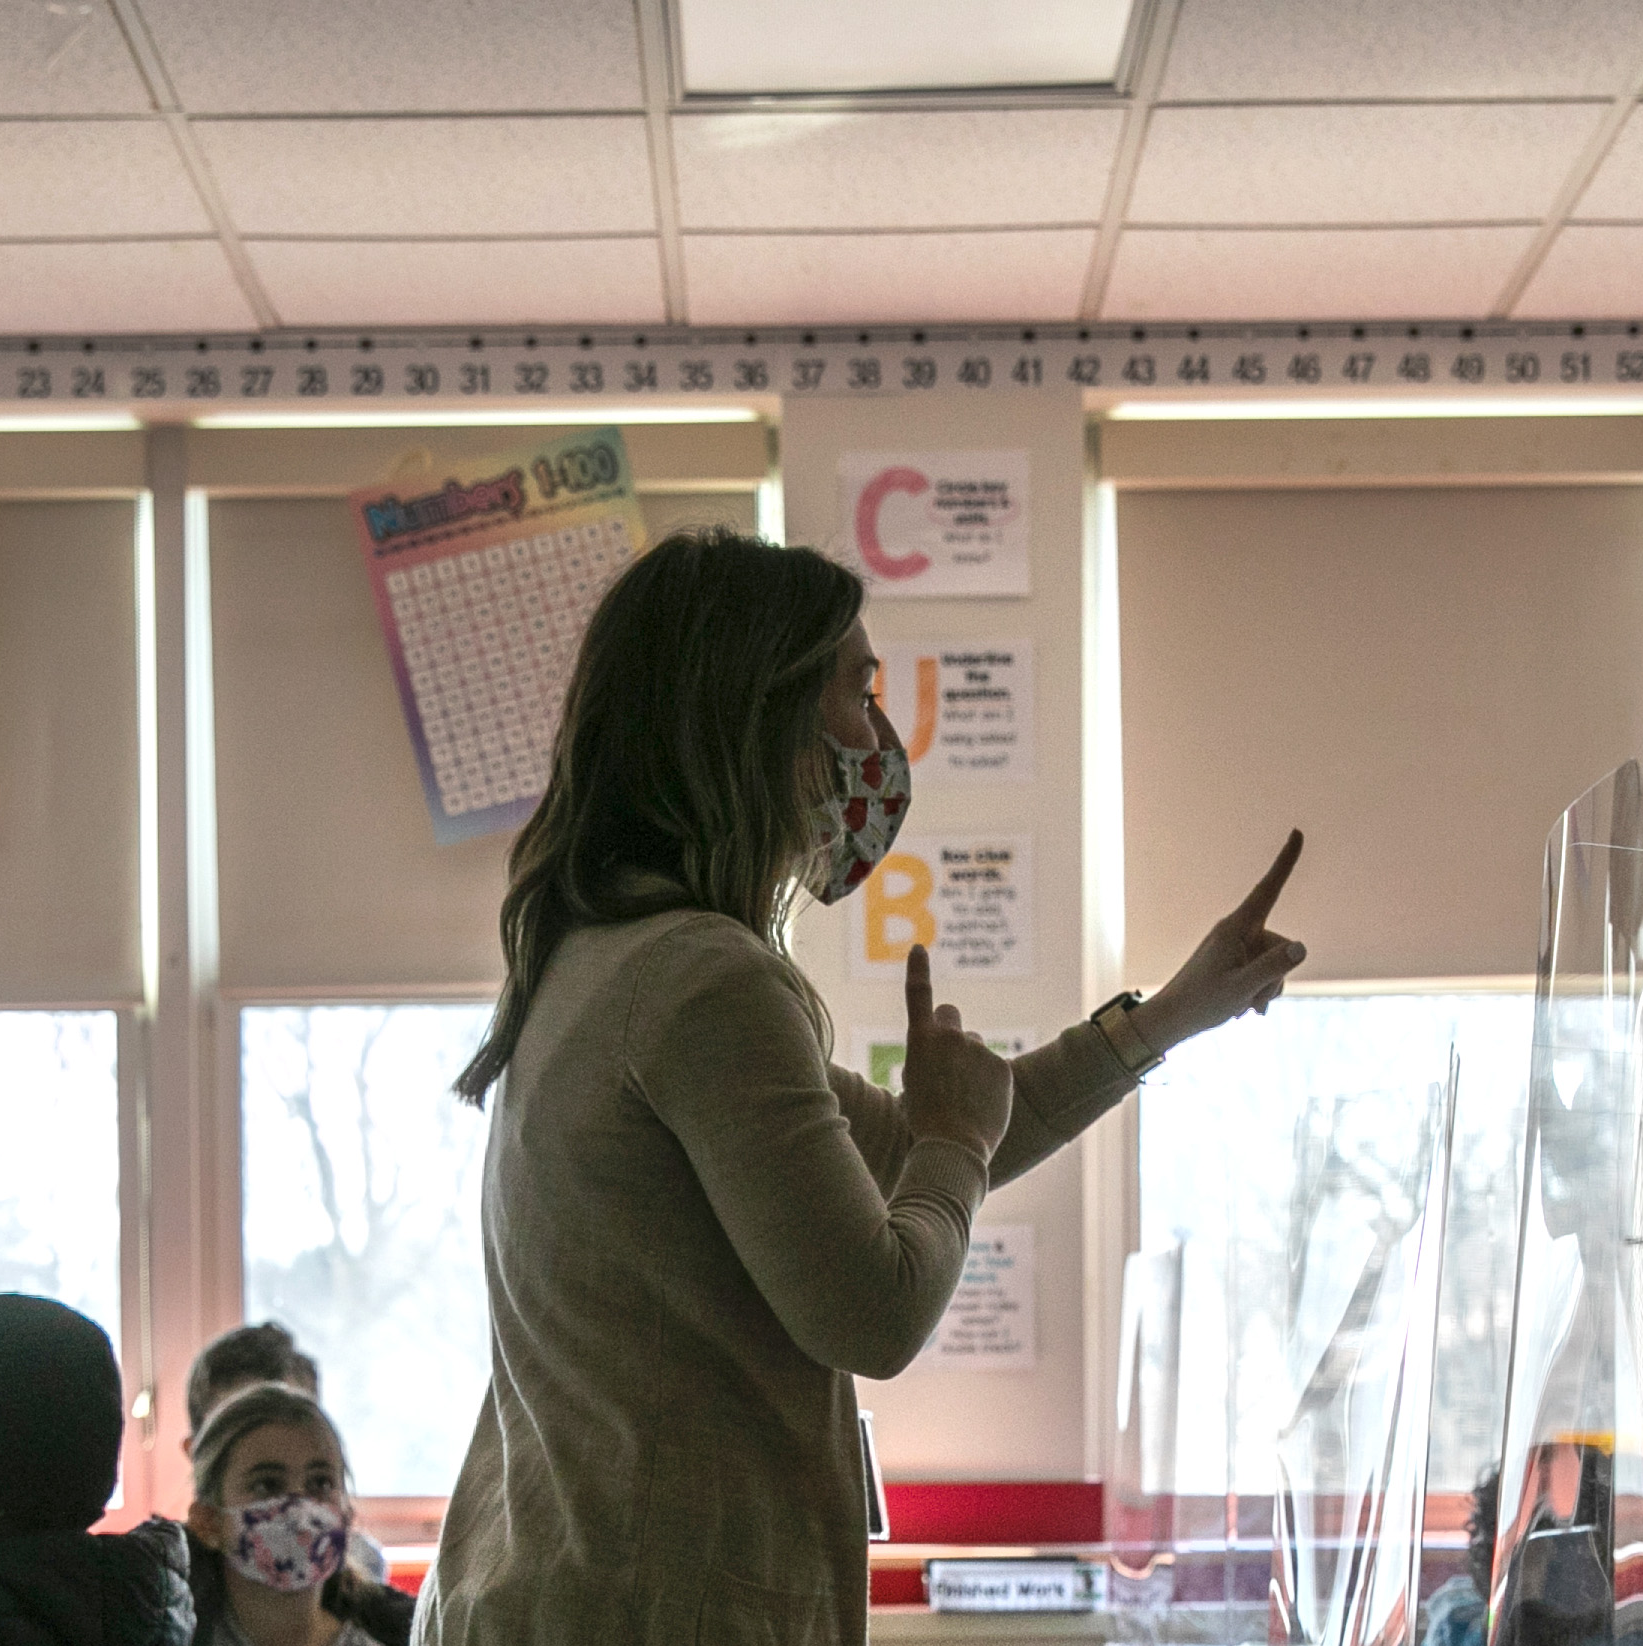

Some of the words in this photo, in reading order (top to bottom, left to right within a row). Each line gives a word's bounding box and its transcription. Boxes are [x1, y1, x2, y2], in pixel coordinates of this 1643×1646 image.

[17, 367, 52, 398] 23
[72, 368, 106, 398] 24
[133, 368, 167, 398] 25
[187, 367, 221, 398] 26
[241, 366, 274, 397] 27
[298, 366, 328, 396] 28
[352, 365, 384, 395] 29
[406, 365, 440, 395] 30
[460, 363, 490, 395] 31
[515, 362, 549, 393] 32
[570, 362, 604, 393] 33
[625, 362, 657, 392] 34
[680, 361, 714, 391] 35
[735, 361, 769, 390] 36
[793, 359, 827, 391] 37
[848, 359, 882, 388] 38
[903, 358, 937, 389] 39
[958, 358, 991, 387] 40
[1012, 356, 1042, 386] 41
[1067, 356, 1101, 385] 42
[1122, 355, 1156, 385] 43
[1177, 356, 1210, 383] 44
[1232, 355, 1266, 384] 45
[1288, 355, 1321, 384] 46
[1342, 353, 1375, 381] 47
[1397, 354, 1431, 382] 48
[1451, 354, 1485, 384] 49
[1506, 353, 1540, 383] 50
[1561, 352, 1591, 383] 51
[366, 468, 525, 540] Numbers
[533, 443, 620, 499] 1-100
[855, 466, 931, 580] C
[865, 852, 936, 962] B
